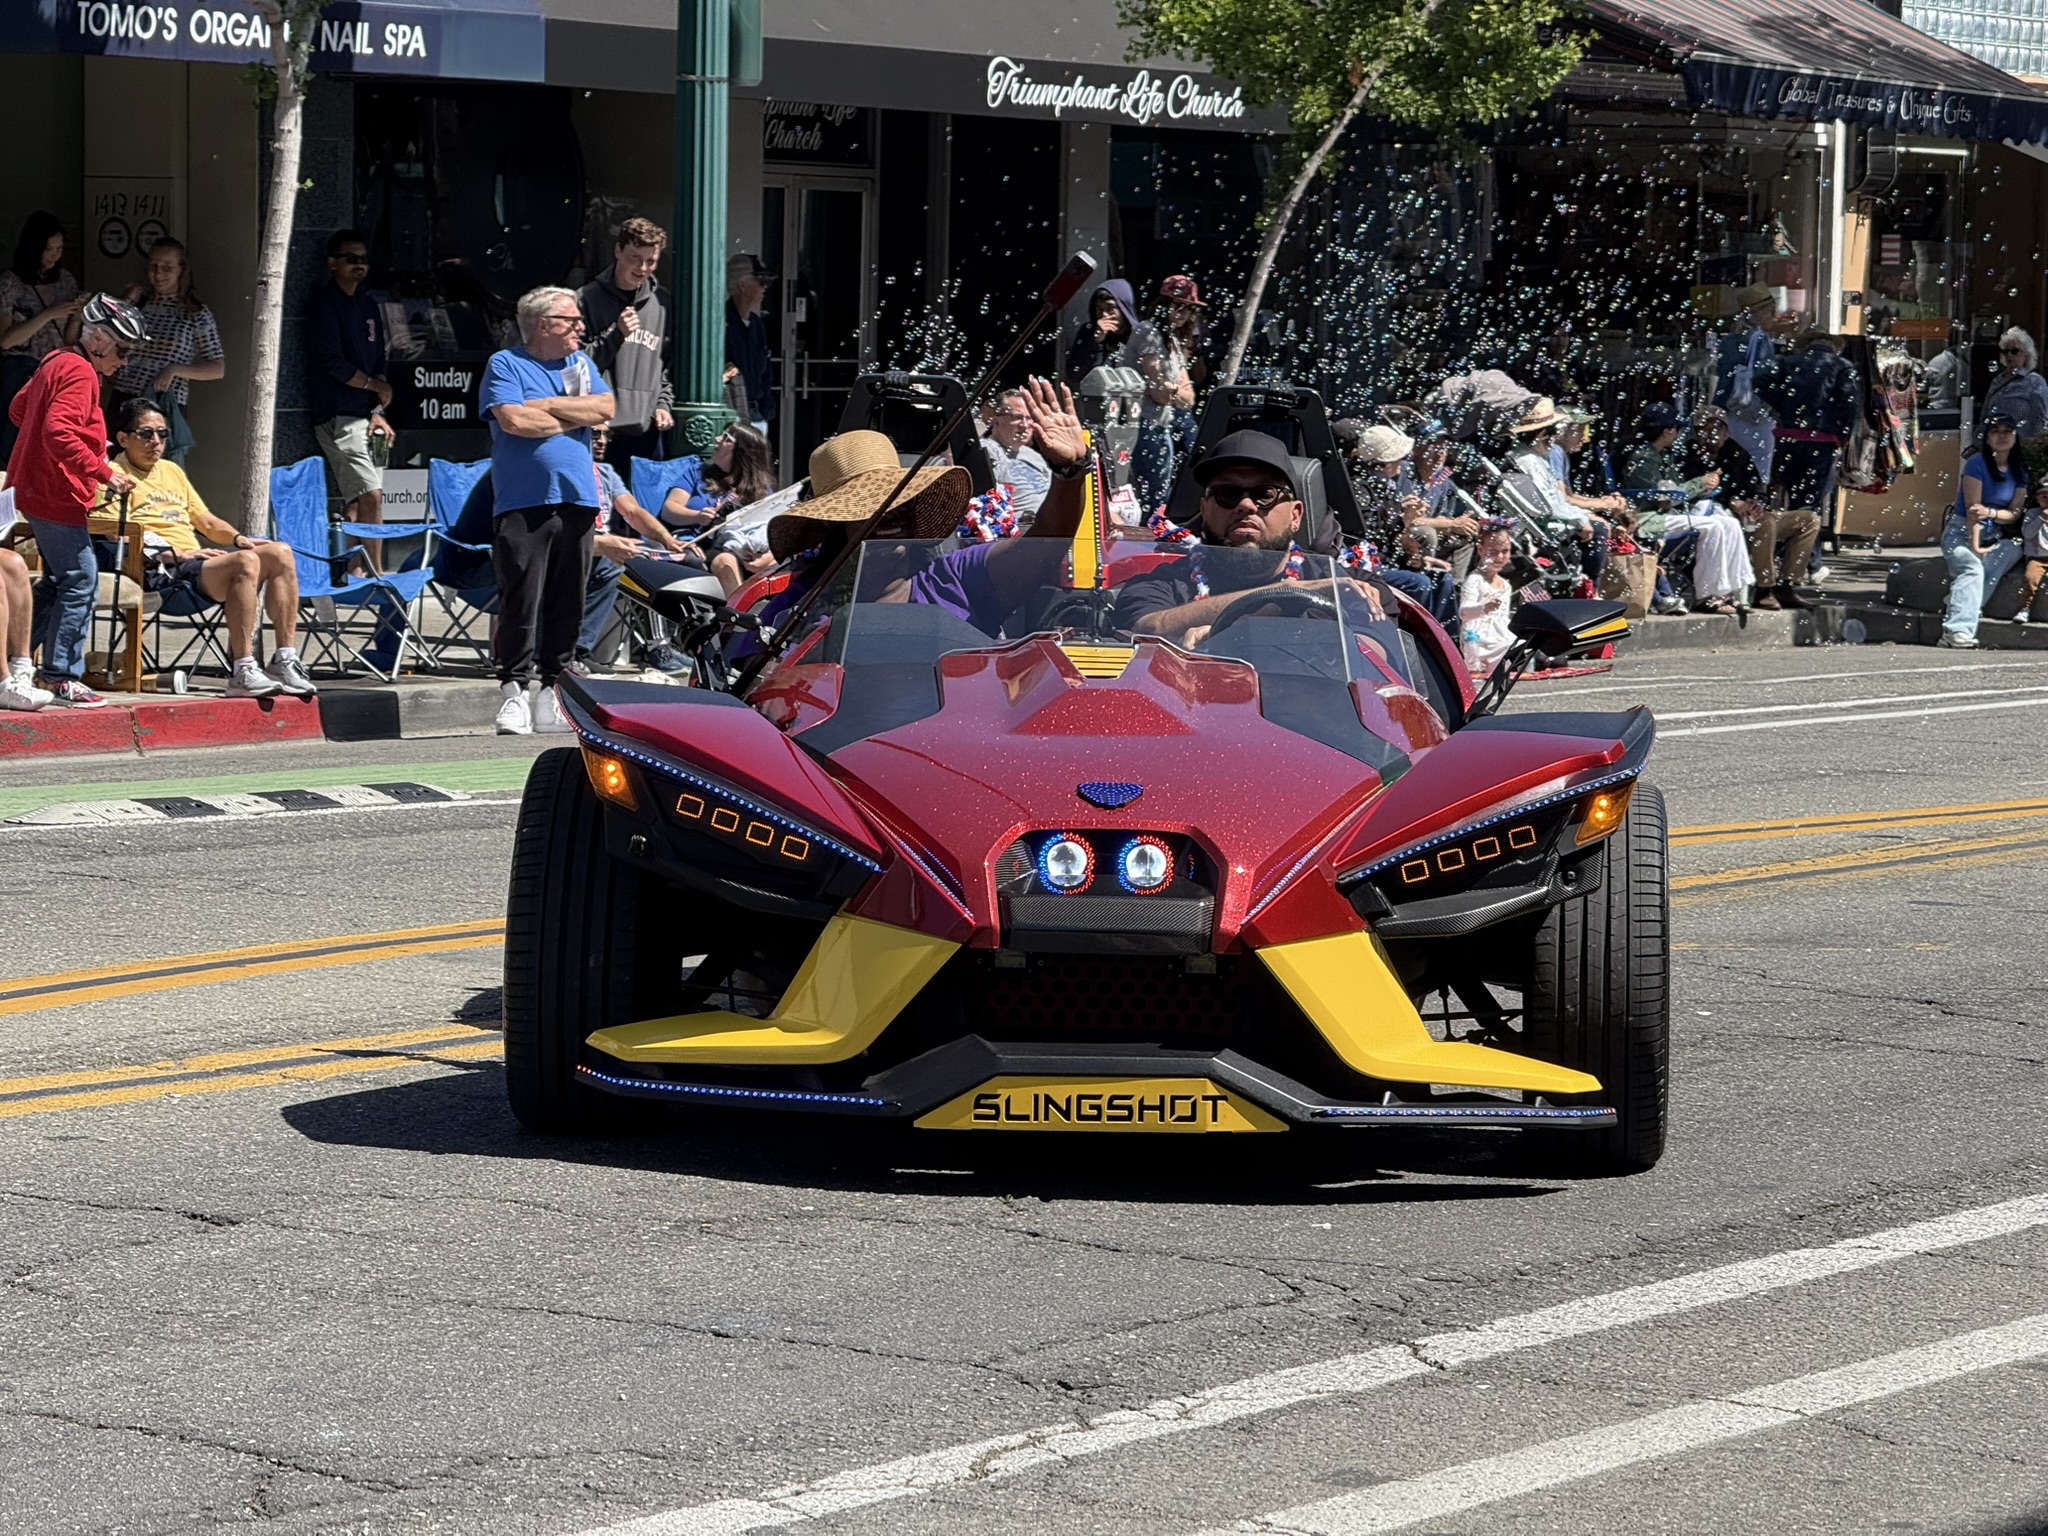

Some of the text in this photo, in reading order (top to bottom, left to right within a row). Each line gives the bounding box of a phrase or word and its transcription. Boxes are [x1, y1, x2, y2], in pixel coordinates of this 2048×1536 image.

[77, 1, 427, 58] TOMO'S ORGAI NAIL SPA
[987, 56, 1245, 124] Triumphant Life Church
[1777, 77, 1971, 127] Global Treasures & Unique Gifts
[764, 118, 823, 151] Church
[94, 193, 165, 217] 1413 1411
[625, 329, 660, 351] NCISCO
[414, 366, 472, 393] Sunday
[420, 398, 466, 419] 10 am
[381, 488, 428, 504] hurch.or
[972, 1093, 1228, 1123] SLINGSHOT
